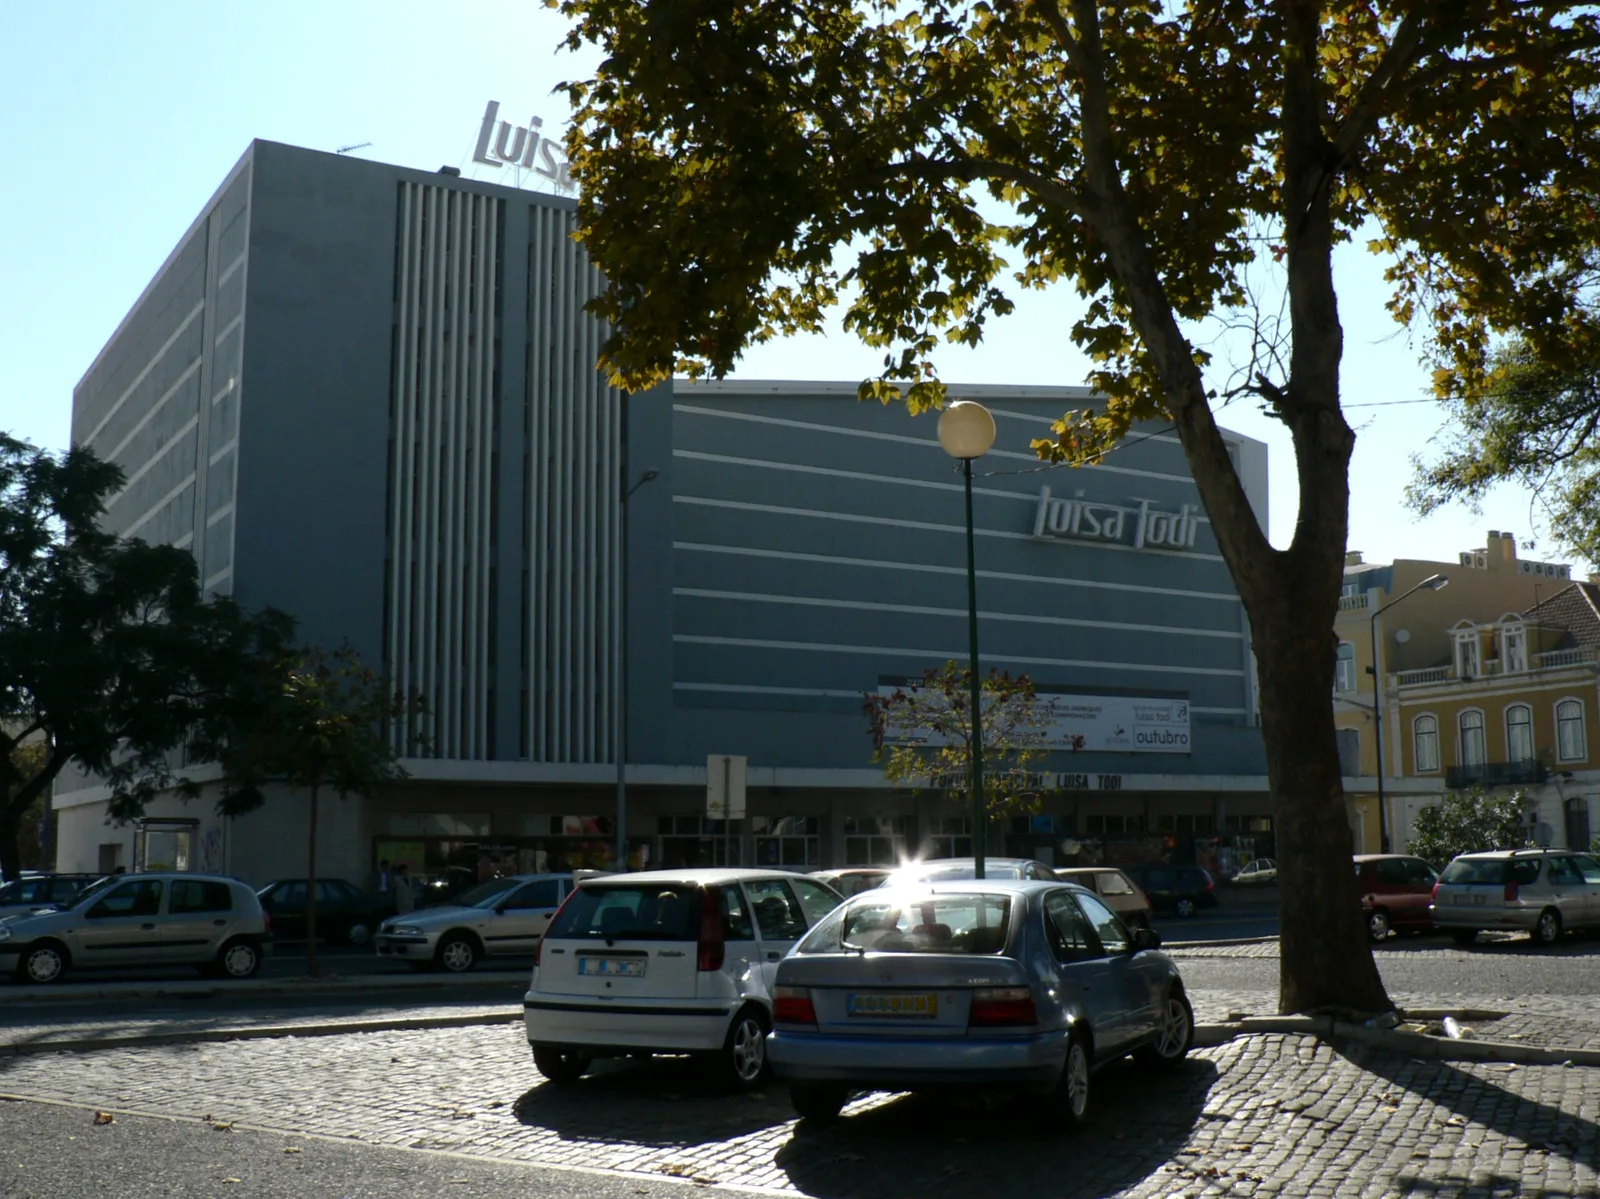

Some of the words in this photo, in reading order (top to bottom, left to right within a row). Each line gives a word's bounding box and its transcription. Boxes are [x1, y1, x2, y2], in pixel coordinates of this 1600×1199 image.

[1034, 485, 1125, 540] Luisa
[1129, 496, 1199, 550] Todi
[1137, 730, 1188, 745] outubro
[1057, 774, 1089, 788] LUISA
[1097, 775, 1122, 789] TODI
